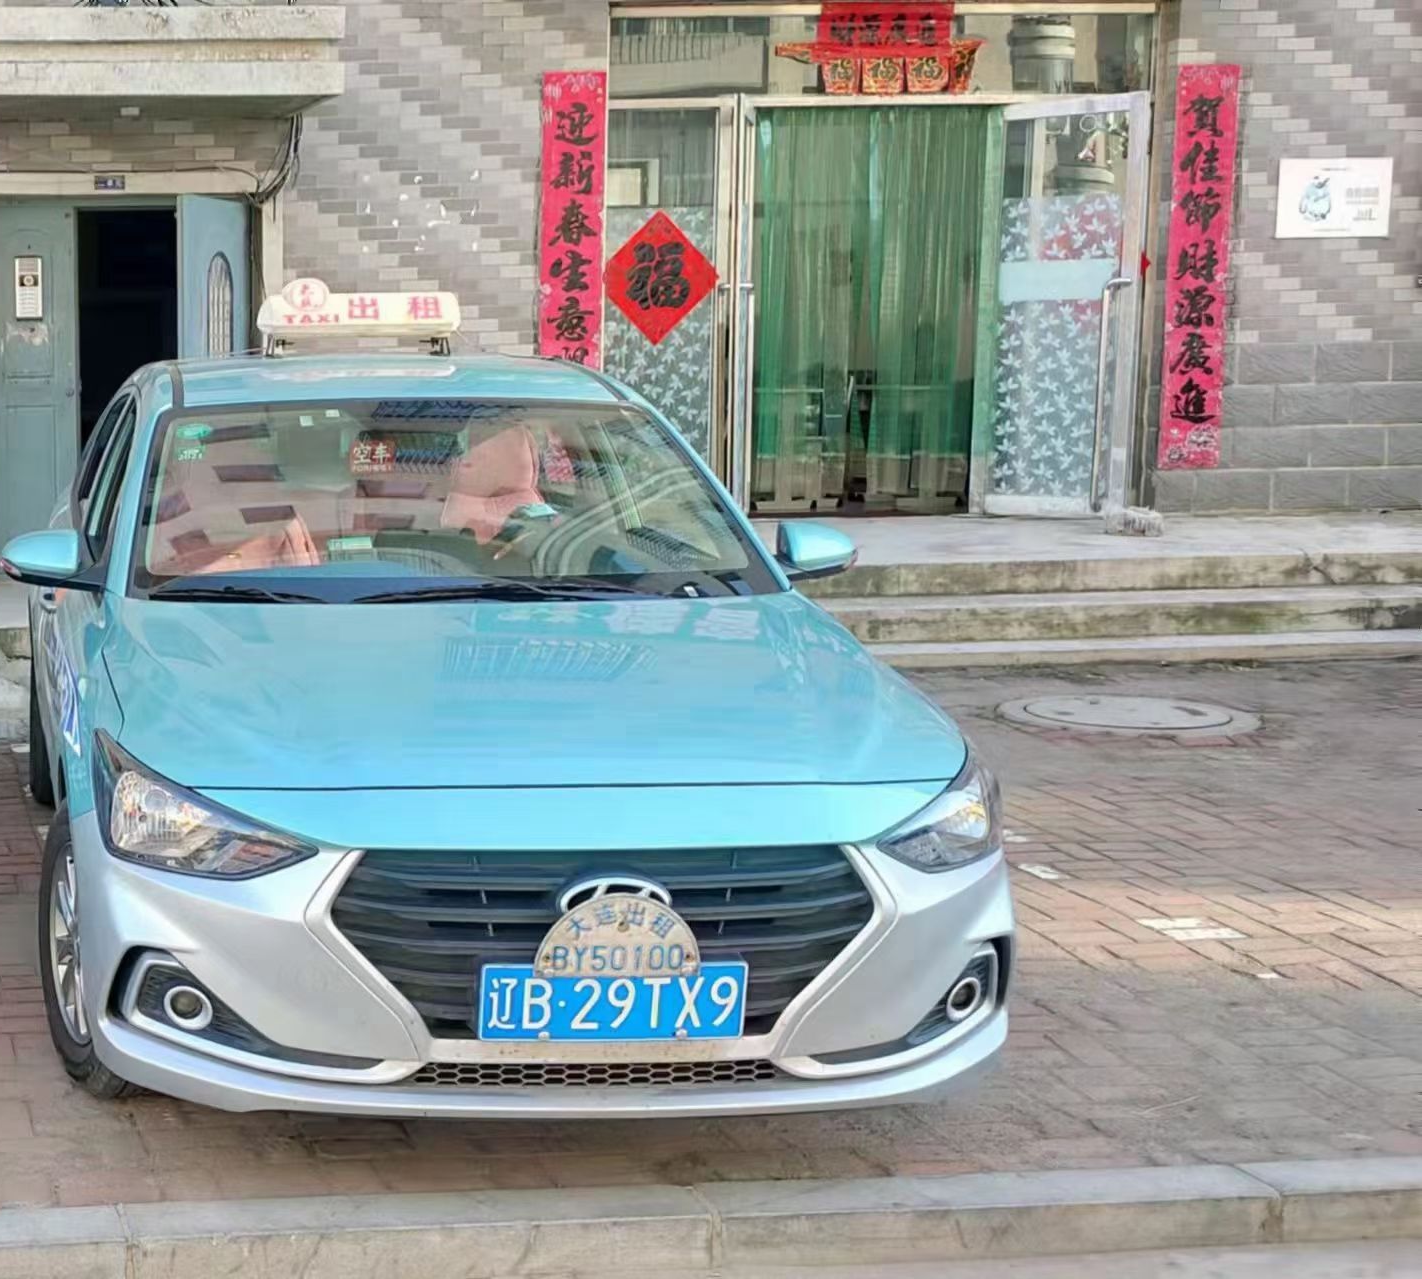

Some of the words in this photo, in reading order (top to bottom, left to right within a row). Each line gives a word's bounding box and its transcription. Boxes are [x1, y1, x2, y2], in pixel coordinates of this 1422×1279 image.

[868, 57, 898, 80] 福
[911, 57, 944, 81] 福
[625, 241, 691, 310] 福
[282, 314, 341, 325] TAXI
[347, 296, 443, 321] 出租
[353, 441, 391, 465] 空车
[566, 902, 677, 940] 大连出租
[551, 943, 685, 972] BY50100
